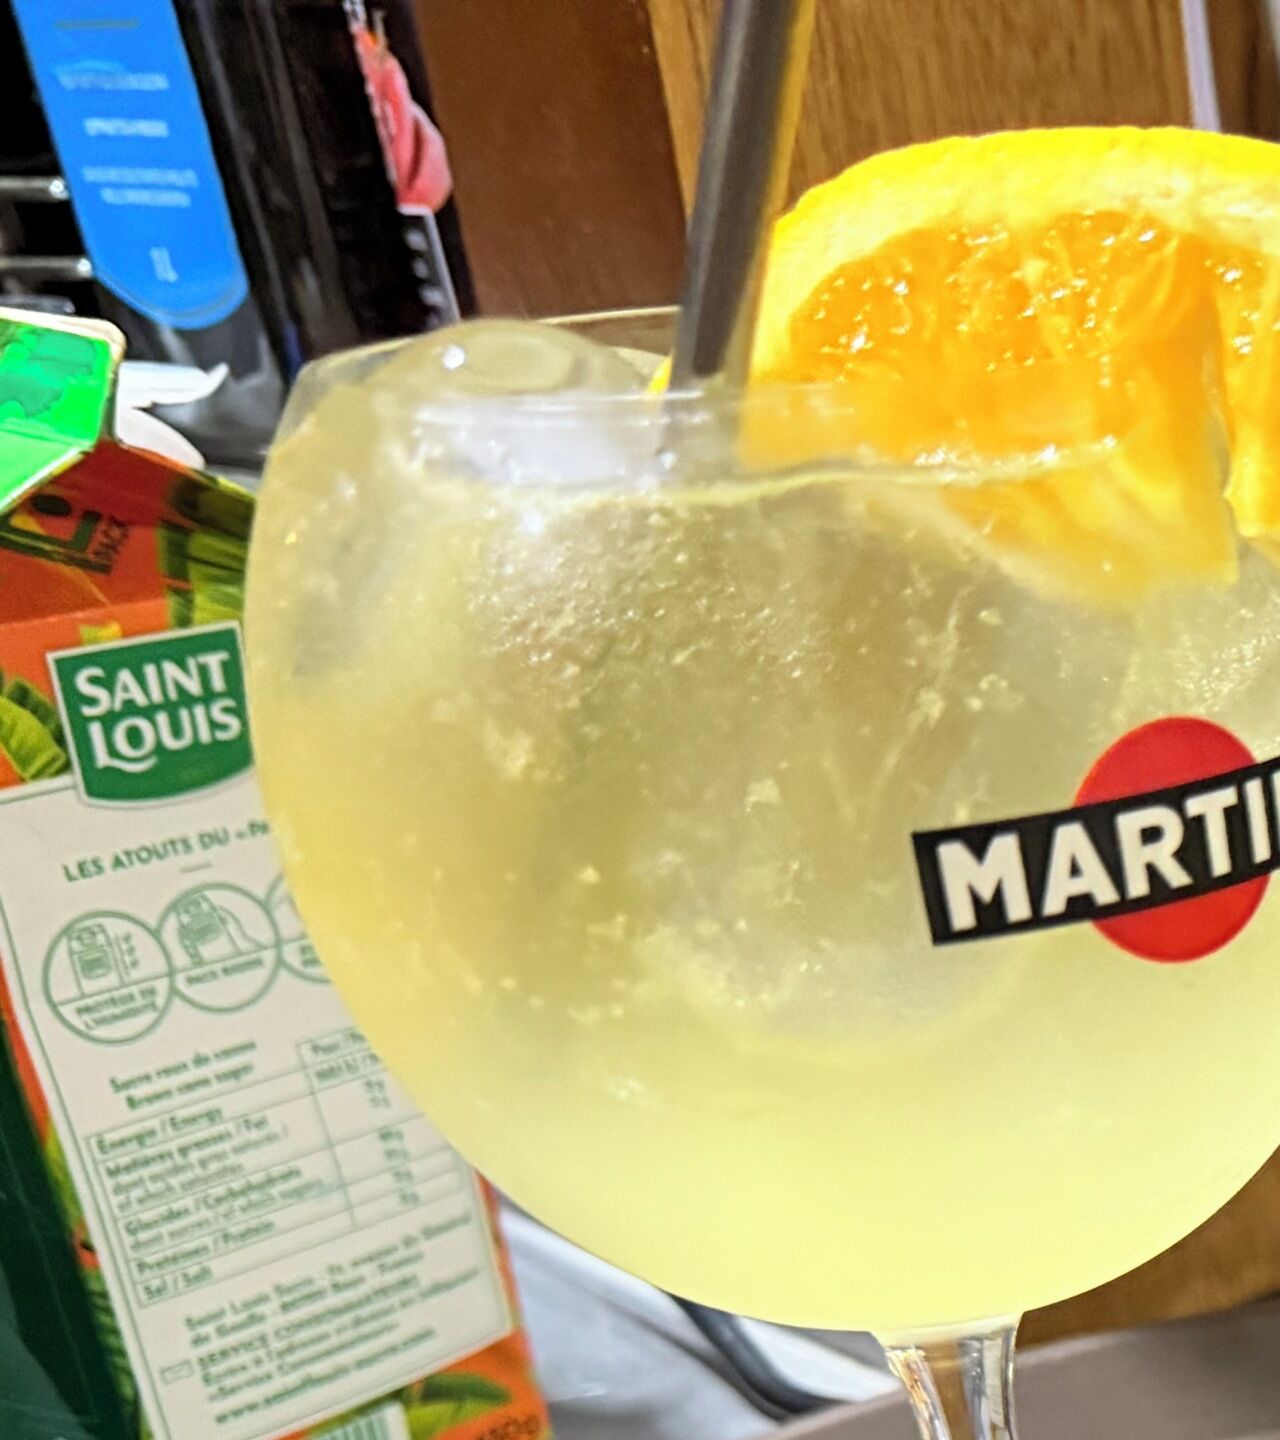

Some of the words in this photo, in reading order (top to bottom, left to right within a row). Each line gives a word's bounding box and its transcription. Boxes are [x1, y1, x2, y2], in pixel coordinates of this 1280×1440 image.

[75, 650, 230, 717] SAINT
[88, 698, 242, 773] LOUIS
[62, 855, 105, 883] LES
[110, 837, 194, 872] ATOUTS
[199, 827, 230, 850] DU
